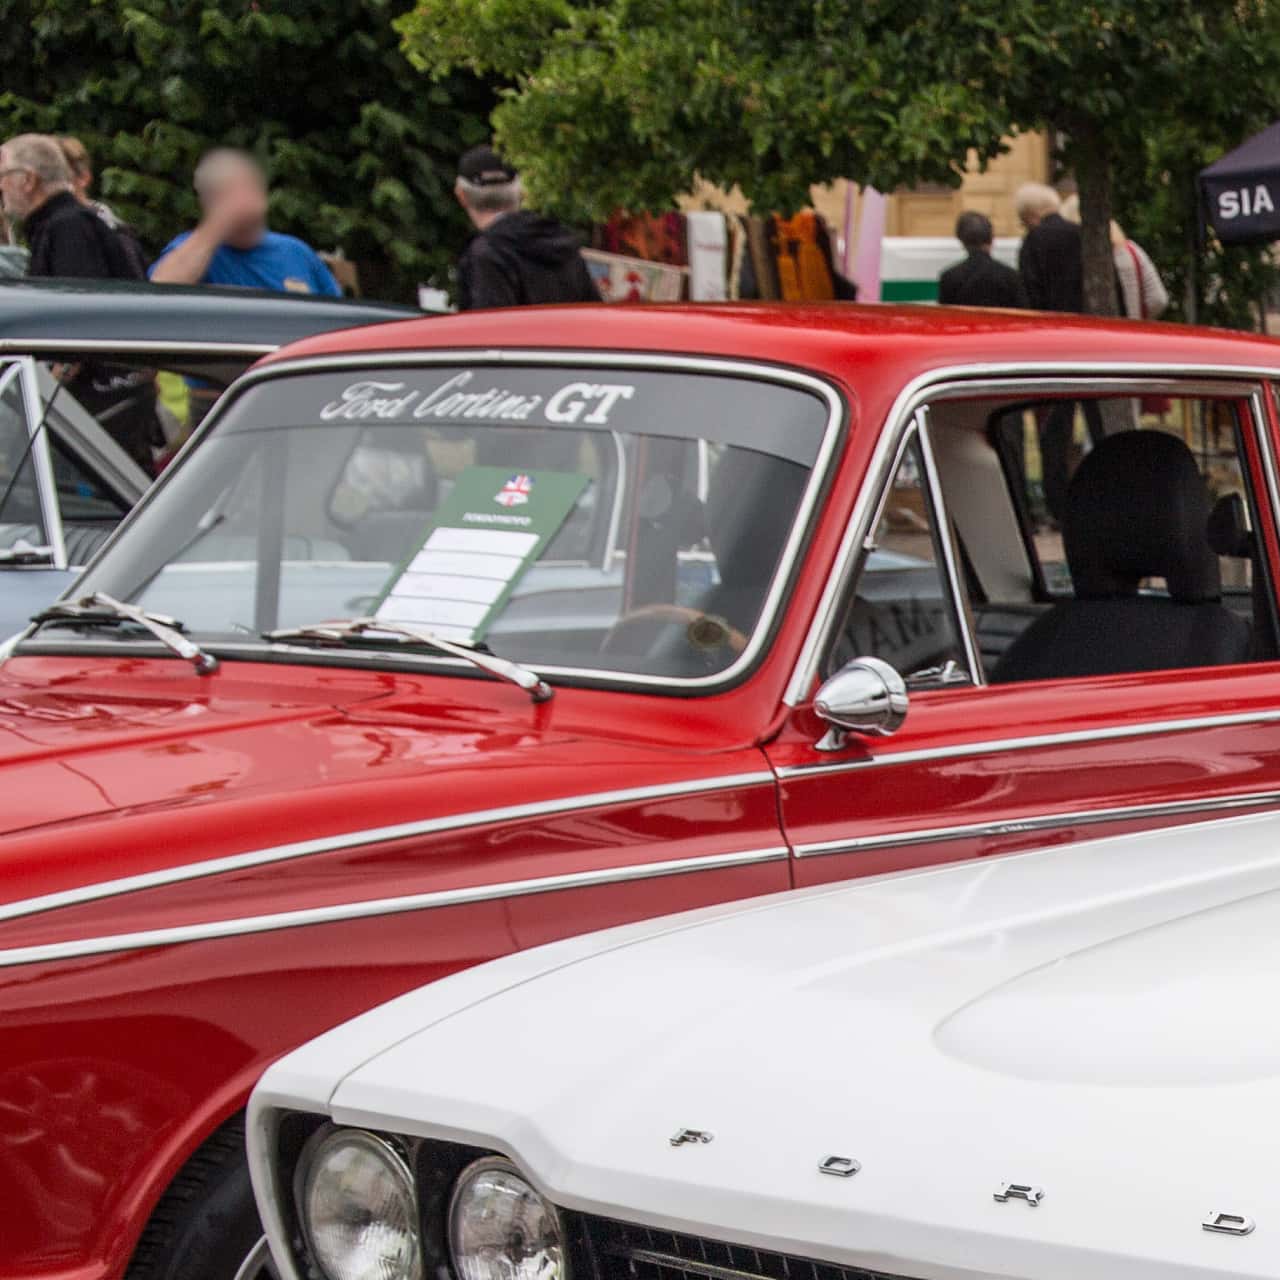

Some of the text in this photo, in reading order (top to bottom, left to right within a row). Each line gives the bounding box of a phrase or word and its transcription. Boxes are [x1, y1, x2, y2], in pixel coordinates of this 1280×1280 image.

[1218, 185, 1274, 219] SIA
[319, 370, 635, 423] Ford Cortina GT
